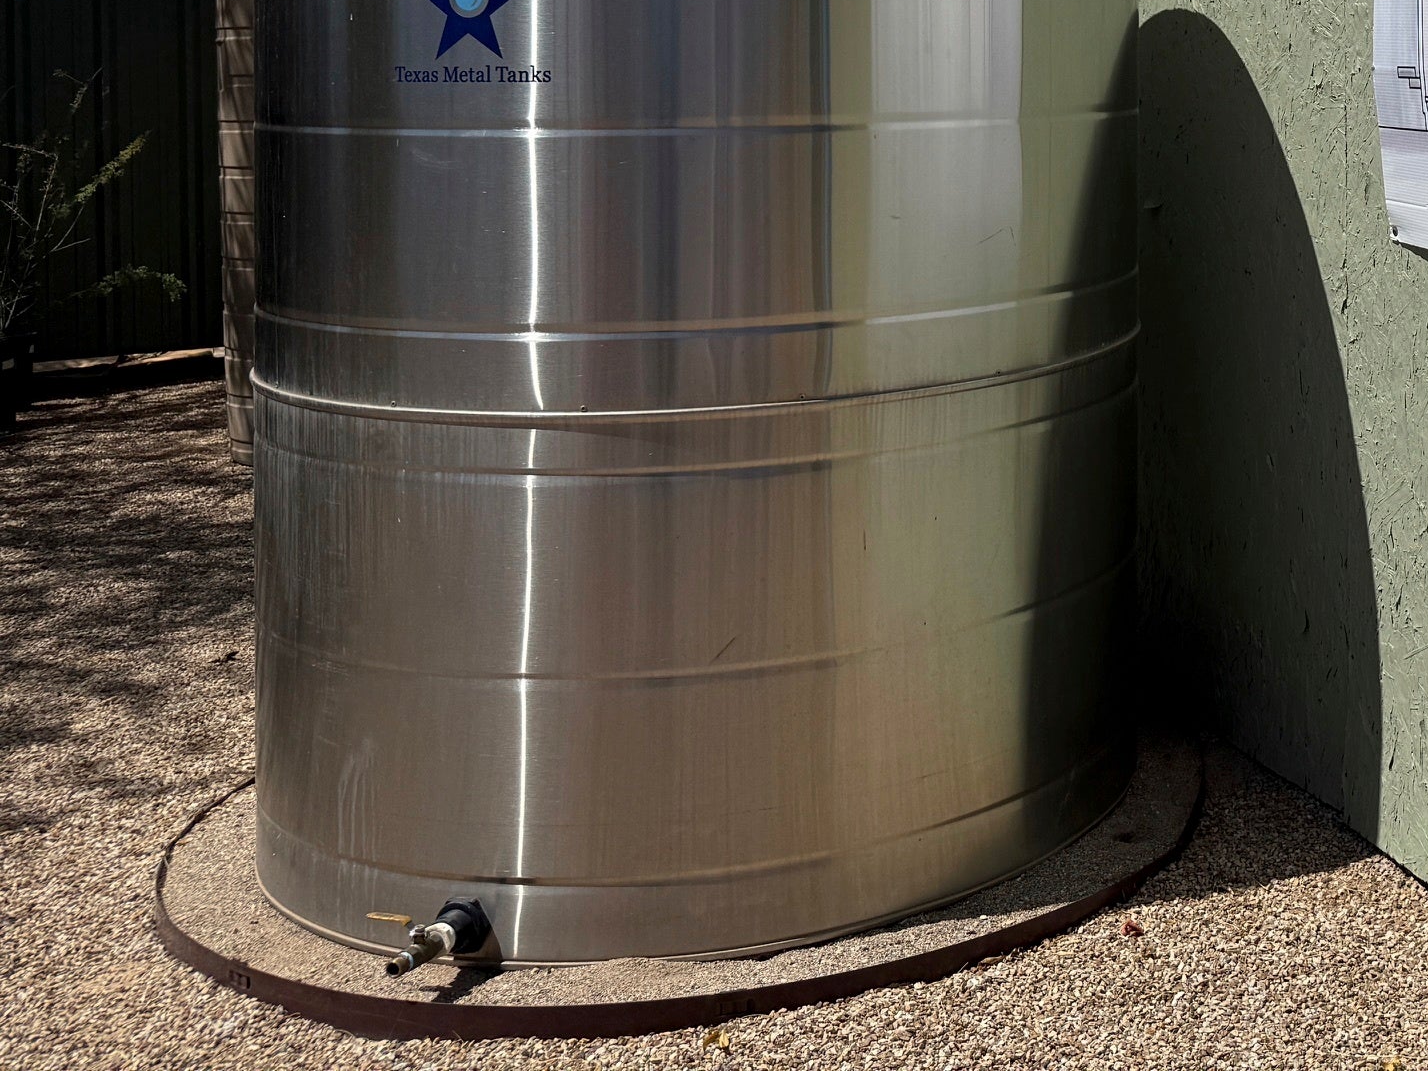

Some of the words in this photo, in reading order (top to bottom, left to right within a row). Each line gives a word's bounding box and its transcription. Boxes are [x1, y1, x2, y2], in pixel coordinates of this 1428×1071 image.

[394, 66, 439, 83] Texas
[443, 64, 491, 83] Metal
[495, 64, 552, 83] Tanks
